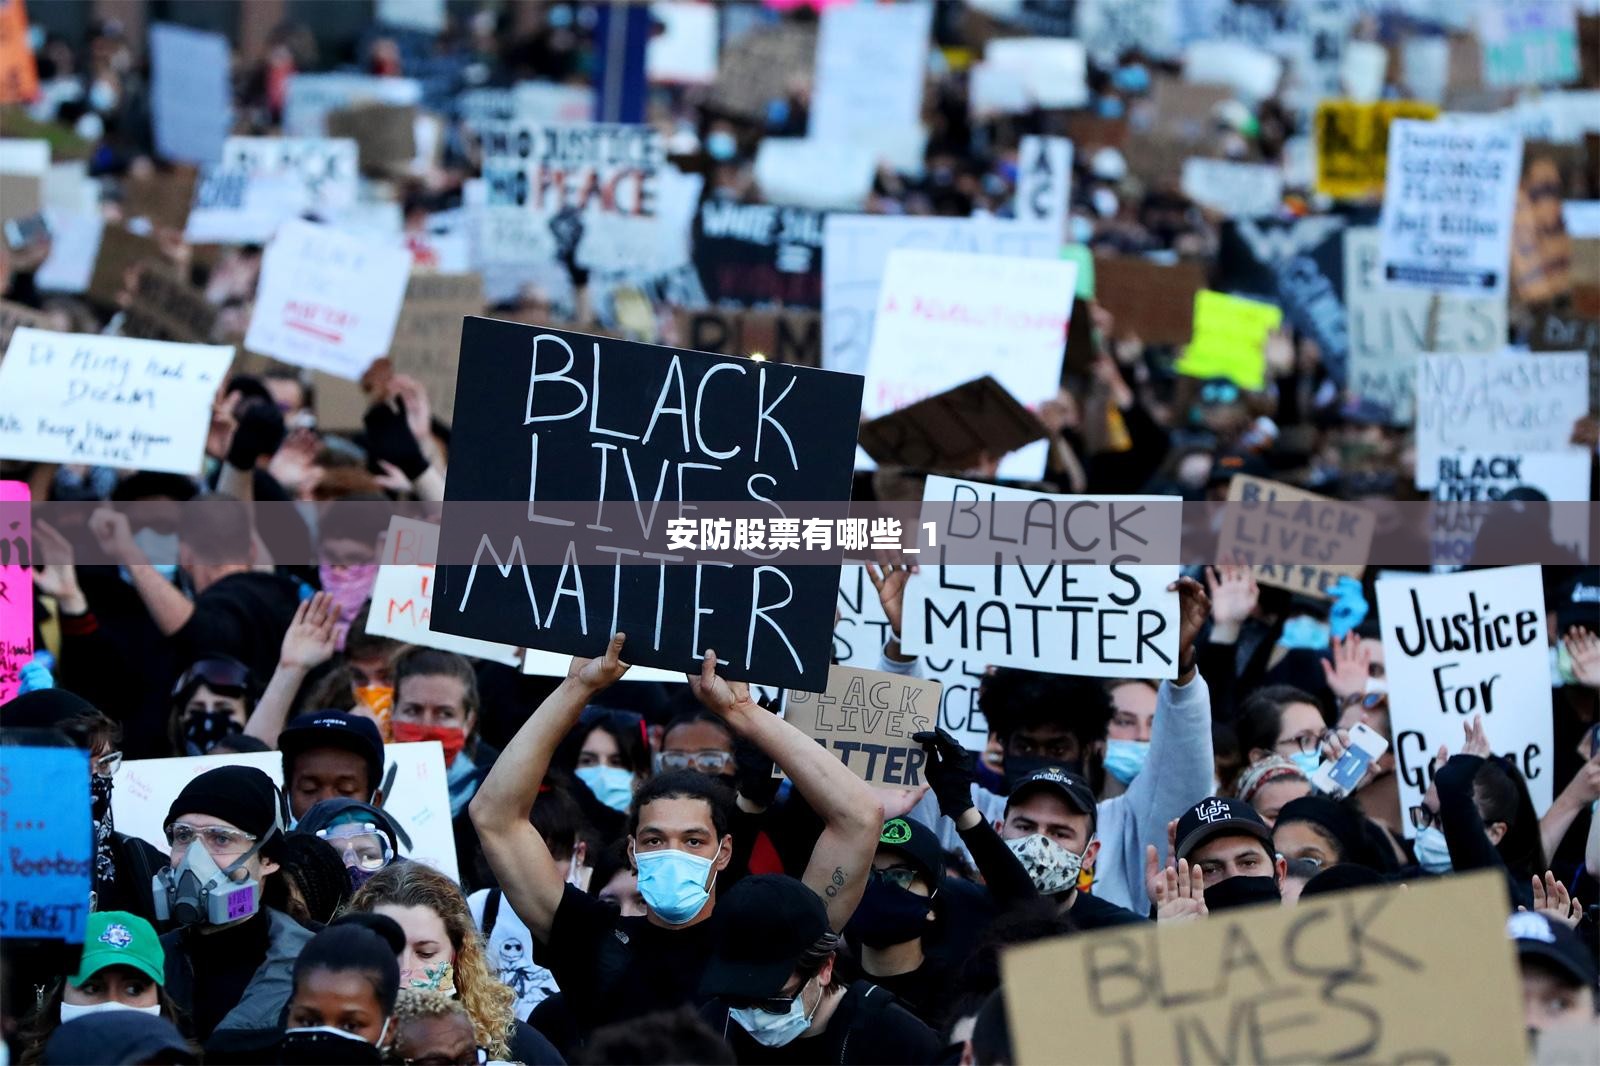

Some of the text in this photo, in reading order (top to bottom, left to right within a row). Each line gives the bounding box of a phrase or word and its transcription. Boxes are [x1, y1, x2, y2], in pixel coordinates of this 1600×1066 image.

[523, 334, 798, 471] BLACK
[527, 432, 788, 559] LIVES
[1437, 456, 1522, 482] BLACK
[946, 484, 1149, 552] BLACK
[1235, 515, 1341, 562] LIVES
[1240, 482, 1359, 538] BLACK
[459, 533, 804, 675] MATTER
[939, 544, 1142, 606] LIVES
[924, 598, 1174, 667] MATTER
[1395, 588, 1539, 657] Justice
[1433, 663, 1502, 714] For
[1082, 888, 1425, 1018] BLACK
